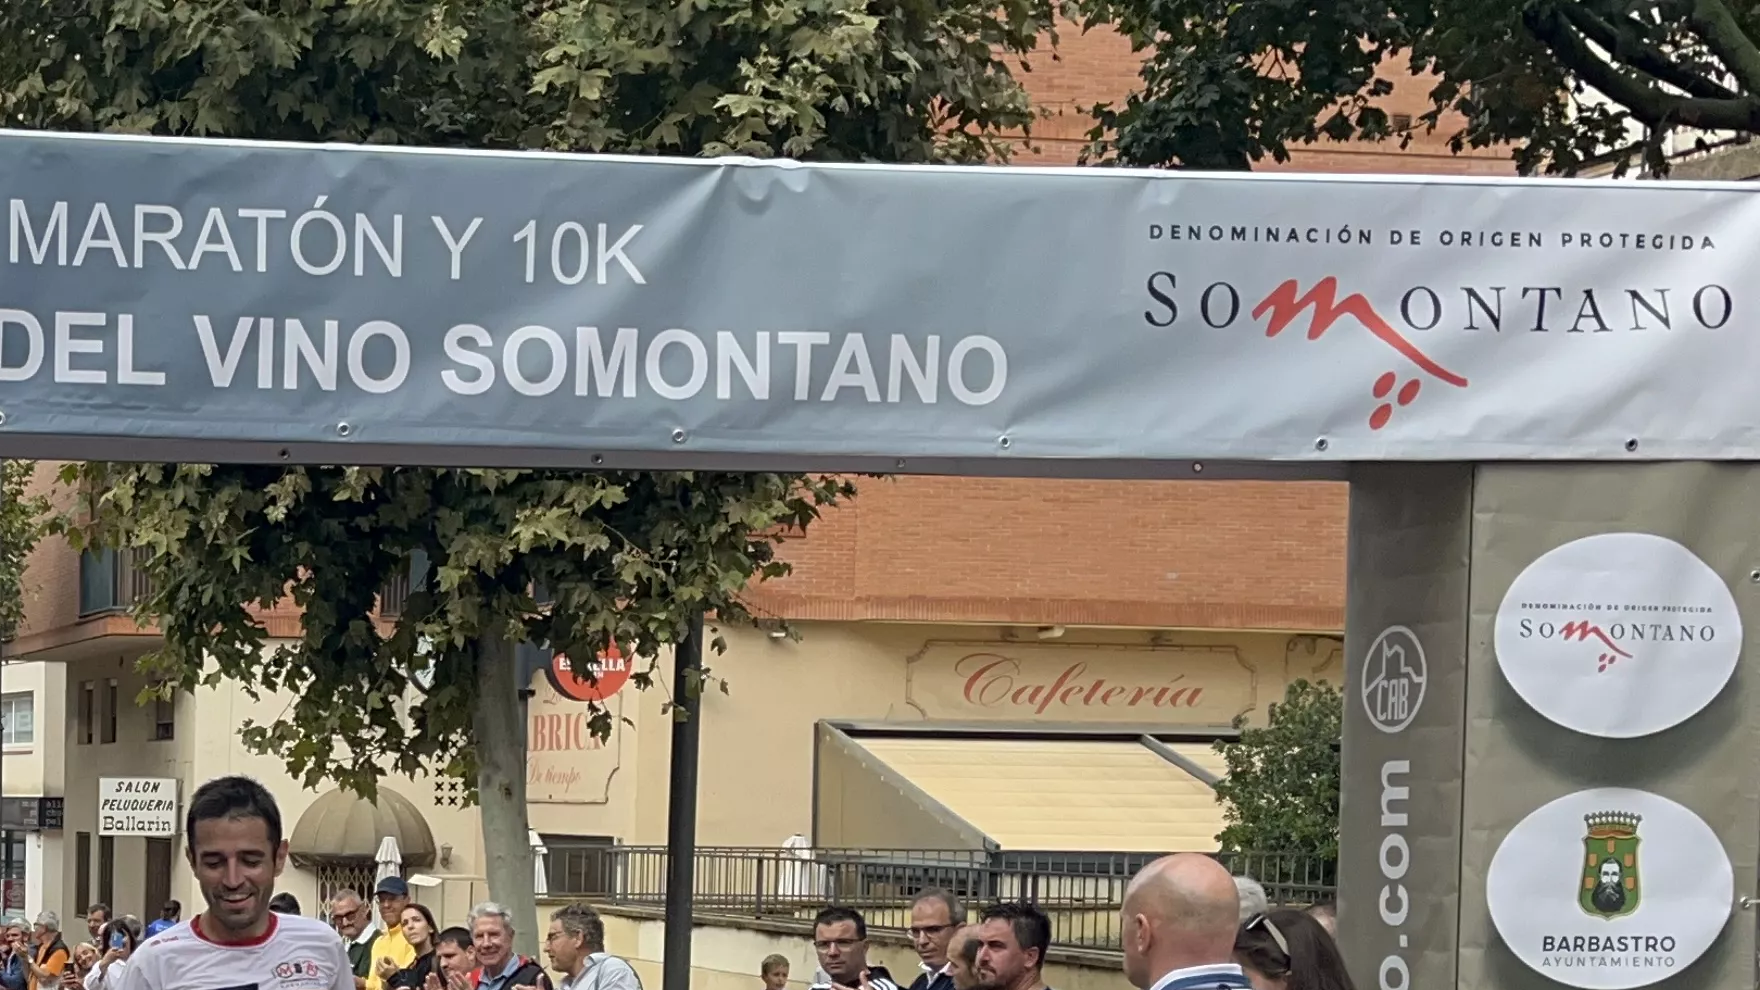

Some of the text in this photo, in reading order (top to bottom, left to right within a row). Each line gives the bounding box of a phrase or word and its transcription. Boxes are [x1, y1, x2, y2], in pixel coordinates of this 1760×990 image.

[9, 195, 404, 279] MARATÓN
[432, 216, 485, 283] Y
[513, 219, 647, 286] 10K
[1149, 223, 1716, 250] DENOMINACIÓN DE ORIGEN PROTEGIDA
[193, 314, 412, 395] VINO
[440, 322, 1009, 407] SOMONTANO
[1521, 602, 1602, 612] DENOMINACIÓN
[1607, 604, 1620, 612] DE
[1624, 604, 1660, 613] ORIGEN
[954, 652, 1206, 716] Cafetería
[1376, 678, 1410, 722] CAB
[115, 780, 161, 794] SALON
[101, 798, 174, 812] PELUQUERIA
[102, 815, 172, 832] Ballarin
[1542, 935, 1676, 953] BARBASTRO
[1542, 955, 1676, 968] AYUNTAMIENTO
